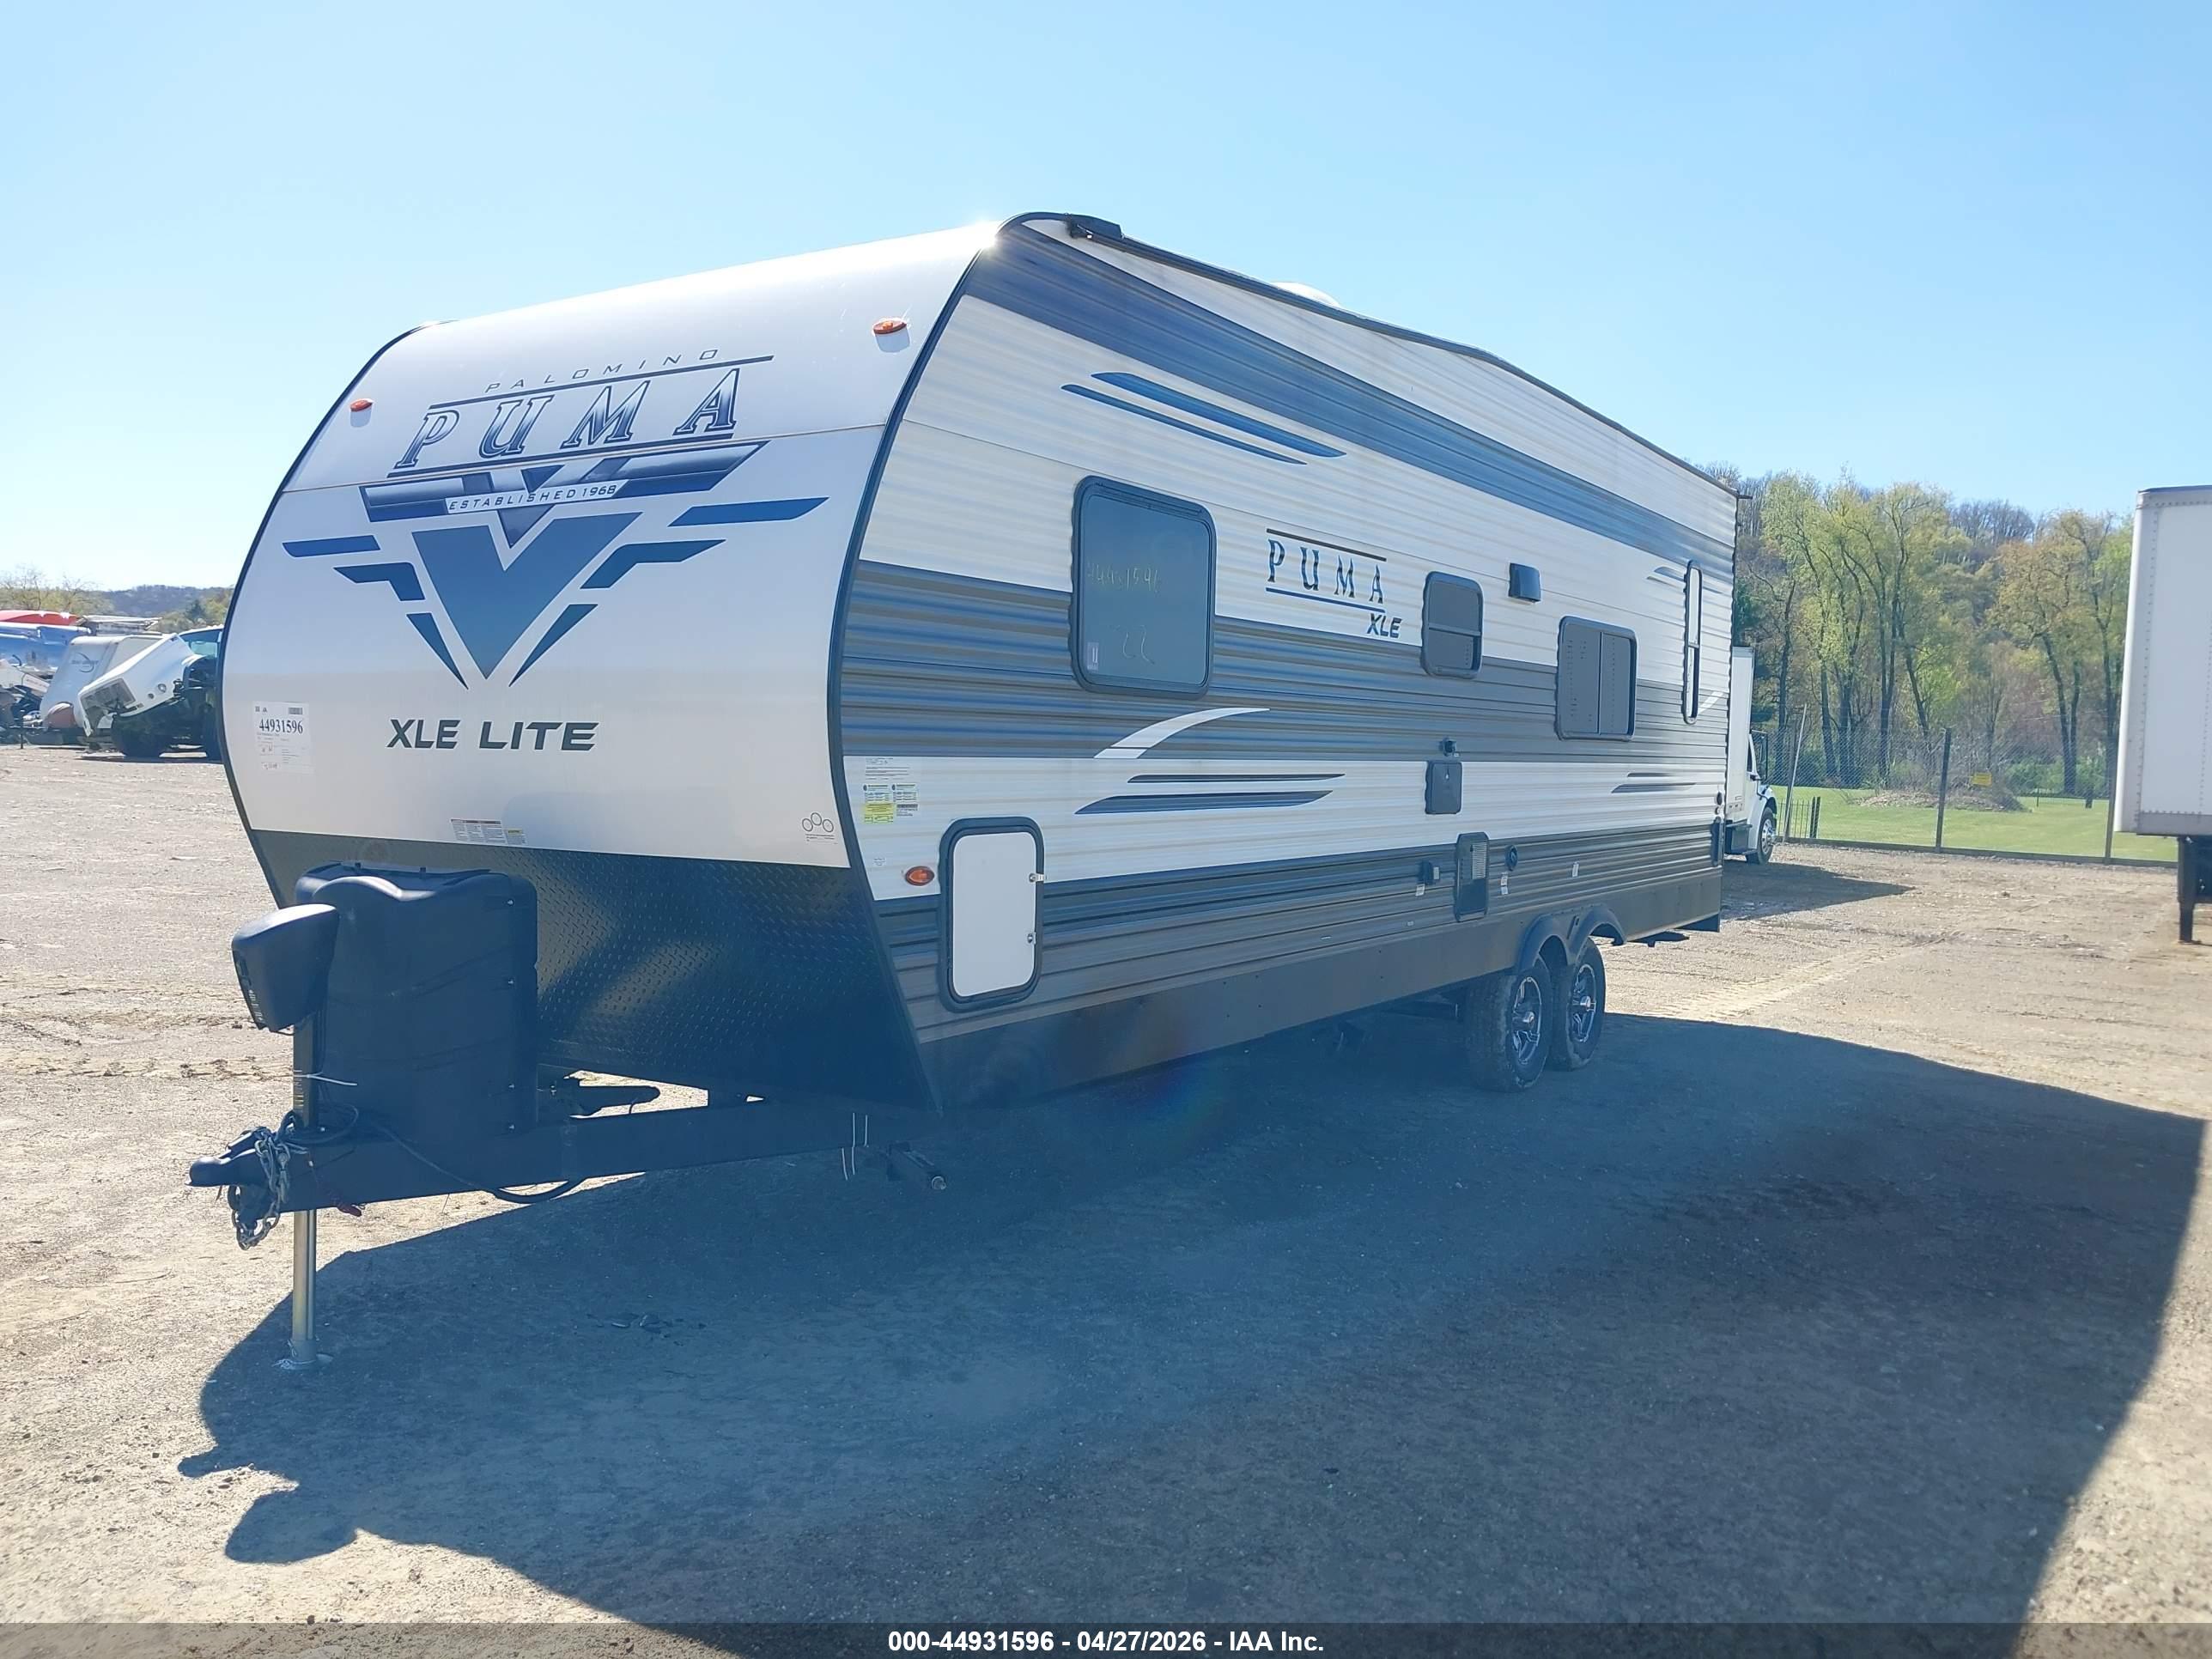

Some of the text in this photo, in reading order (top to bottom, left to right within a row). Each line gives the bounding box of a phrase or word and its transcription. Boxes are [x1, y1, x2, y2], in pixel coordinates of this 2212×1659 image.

[484, 349, 719, 393] PALOMINO
[393, 367, 741, 469] PUMA
[448, 484, 617, 510] ESTABLISHED 1968
[1267, 538, 1383, 605] PUMA
[1366, 612, 1402, 639] XLE
[258, 718, 304, 734] 44931596
[386, 718, 600, 751] XLE LITE
